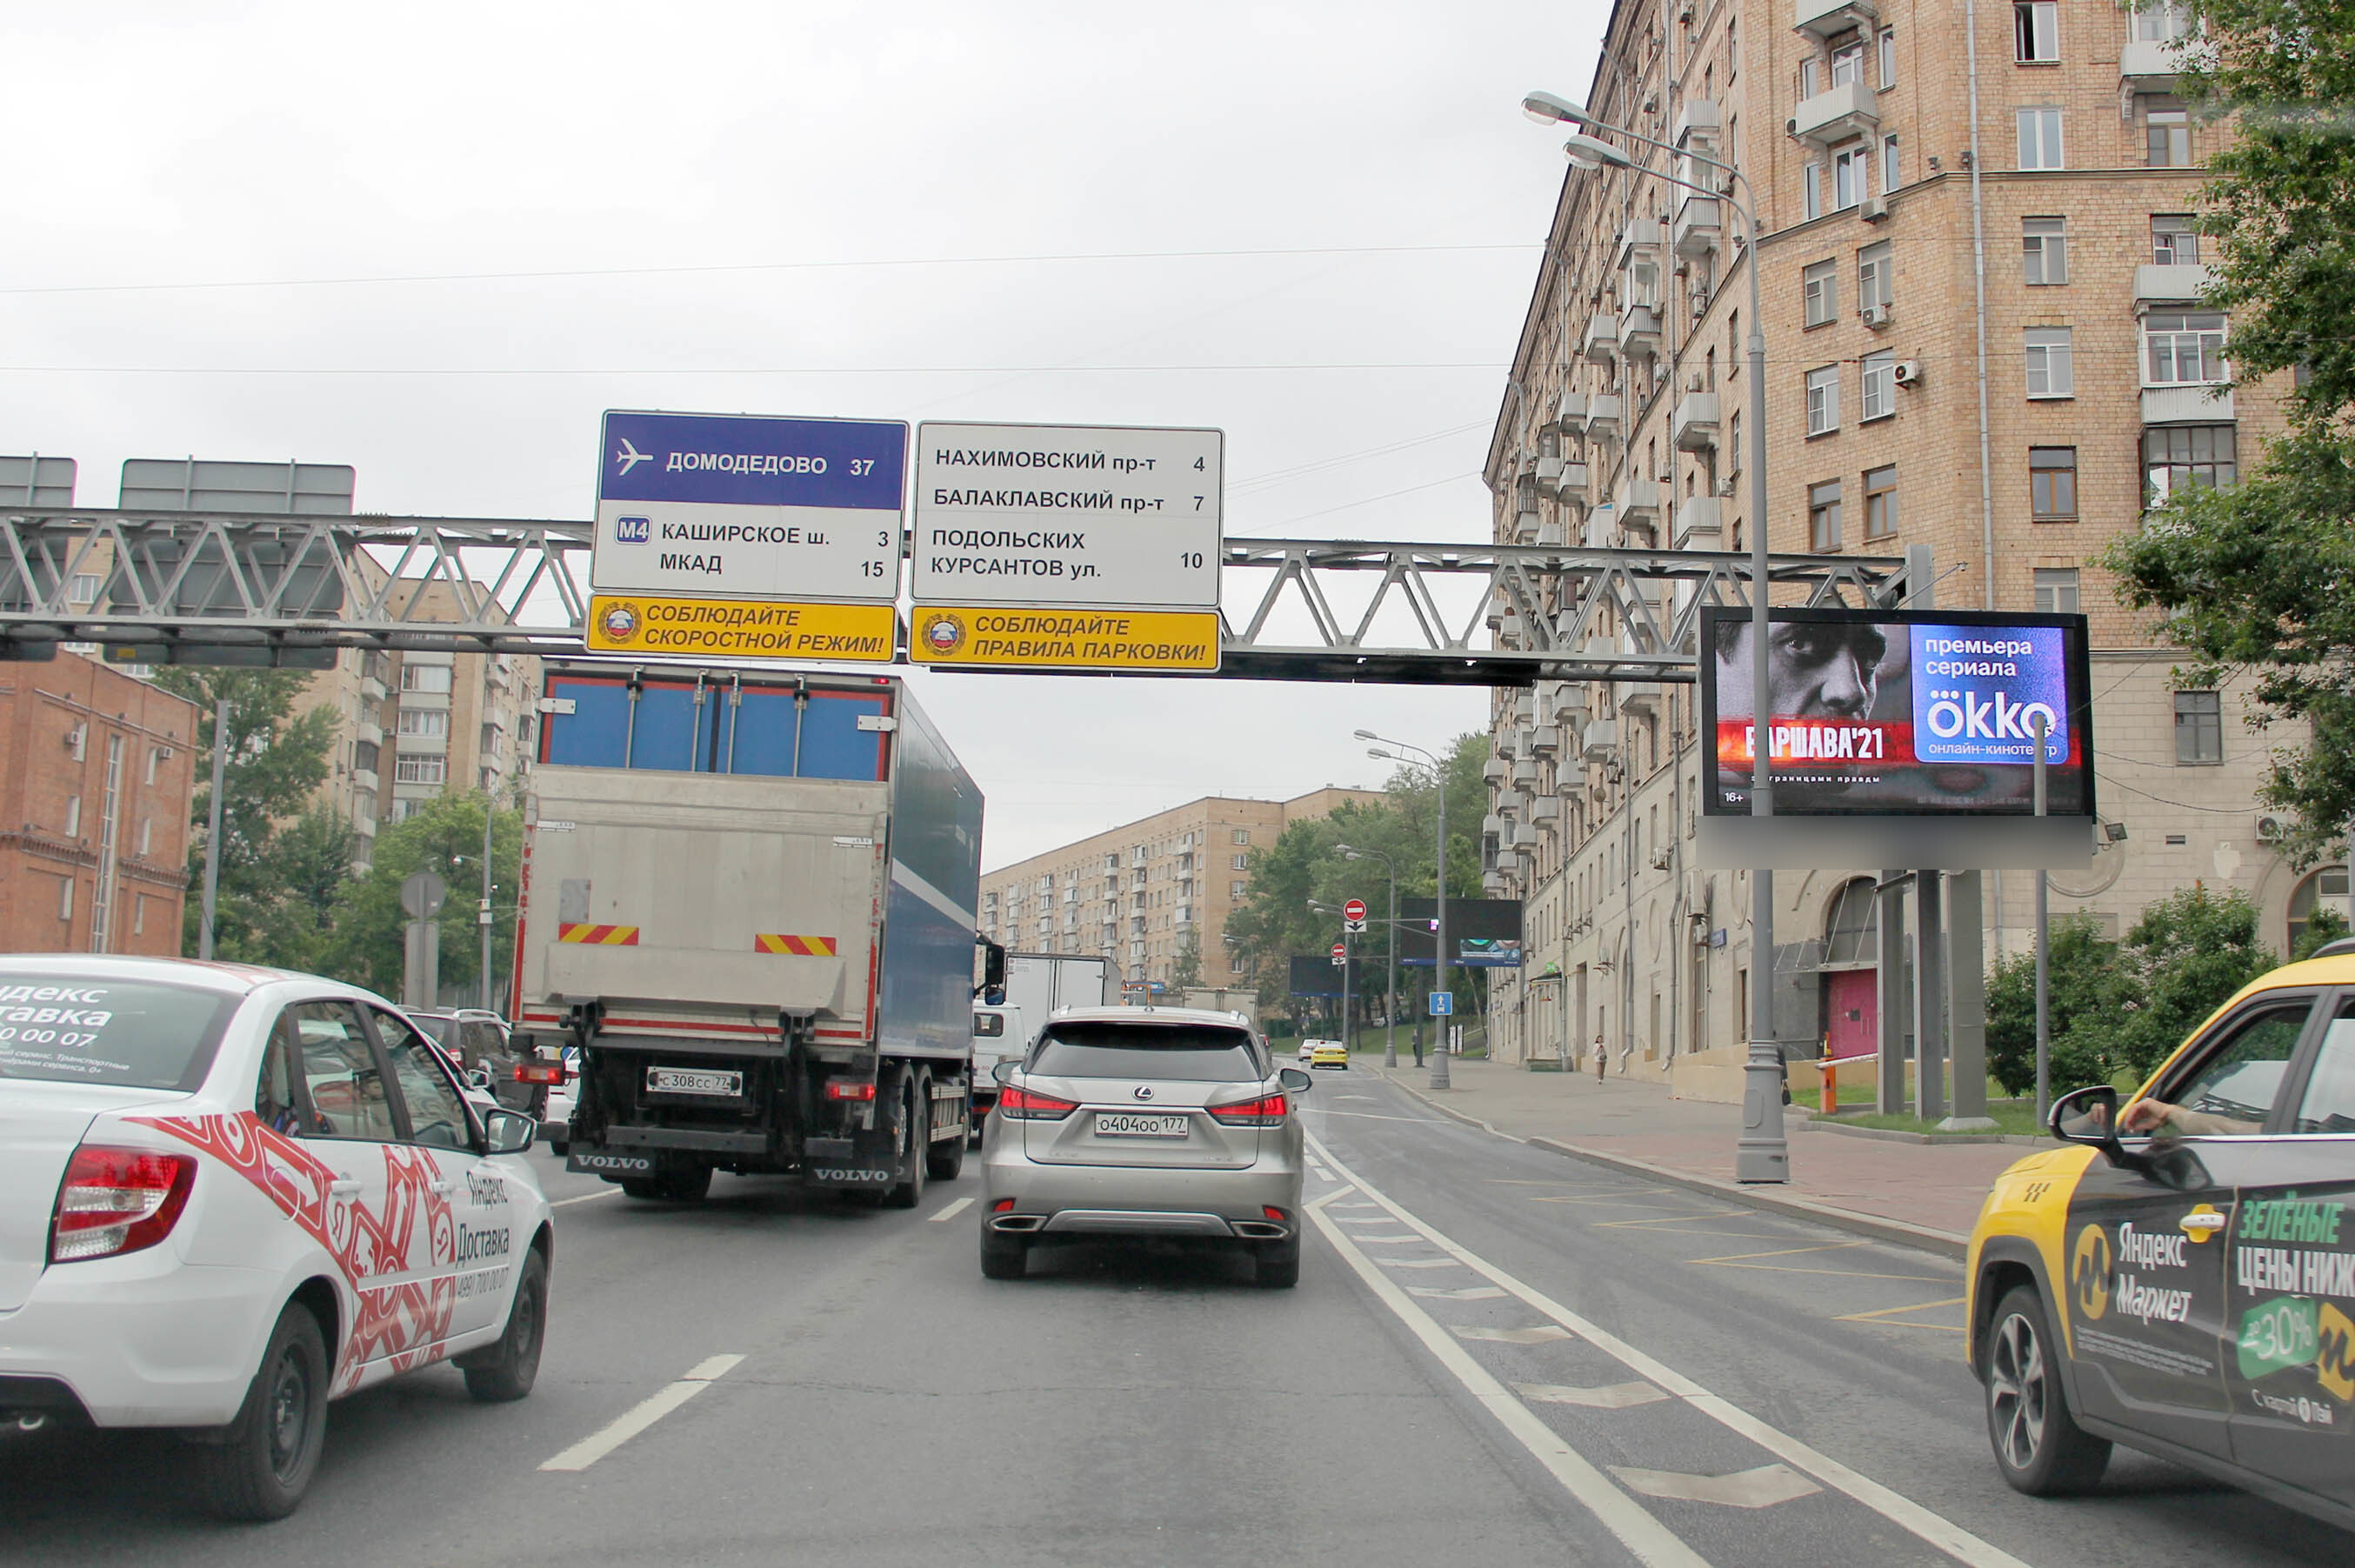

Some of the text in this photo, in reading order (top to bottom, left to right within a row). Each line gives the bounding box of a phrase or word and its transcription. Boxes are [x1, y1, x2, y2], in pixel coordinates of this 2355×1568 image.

[666, 452, 875, 477] ДОМОДЕДОВО 37
[935, 449, 1205, 474] НАХИМОВСКИЙ пр-т 4
[933, 489, 1204, 514] БАЛАКЛАВСКИЙ пр-т 7
[618, 520, 649, 539] М4
[661, 524, 889, 548] КАШИРСКОЕ ш. 3
[932, 530, 1086, 550] ПОДОЛЬСКИХ
[660, 553, 884, 577] МКАД 15
[931, 557, 1102, 581] КУРСАНТОВ ул.
[1180, 552, 1204, 569] 10
[646, 604, 801, 627] СОБЛЮДАЙТЕ
[975, 614, 1131, 637] СОБЛЮДАЙТЕ
[645, 629, 885, 653] СКОРОСТНОЙ РЕЖИМ!
[973, 639, 1207, 661] ПРАВИЛА ПАРКОВКИ!
[1925, 639, 2032, 657] премьера
[1925, 661, 2017, 678] сериала
[1928, 743, 2058, 757] онлайн-кинотер
[1725, 792, 1745, 803] 16+
[20, 1028, 57, 1044] 00
[60, 1031, 98, 1047] 07
[575, 1153, 650, 1171] VOLVO
[813, 1167, 889, 1183] VOLVO
[466, 1171, 509, 1211] Яндекс
[2238, 1190, 2345, 1244] ЗЕЛЁНЫЕ
[456, 1223, 510, 1270] Доставка
[2118, 1222, 2188, 1271] Яндекс
[2238, 1245, 2301, 1296] ЦЕНЫ
[2116, 1273, 2192, 1325] Маркет
